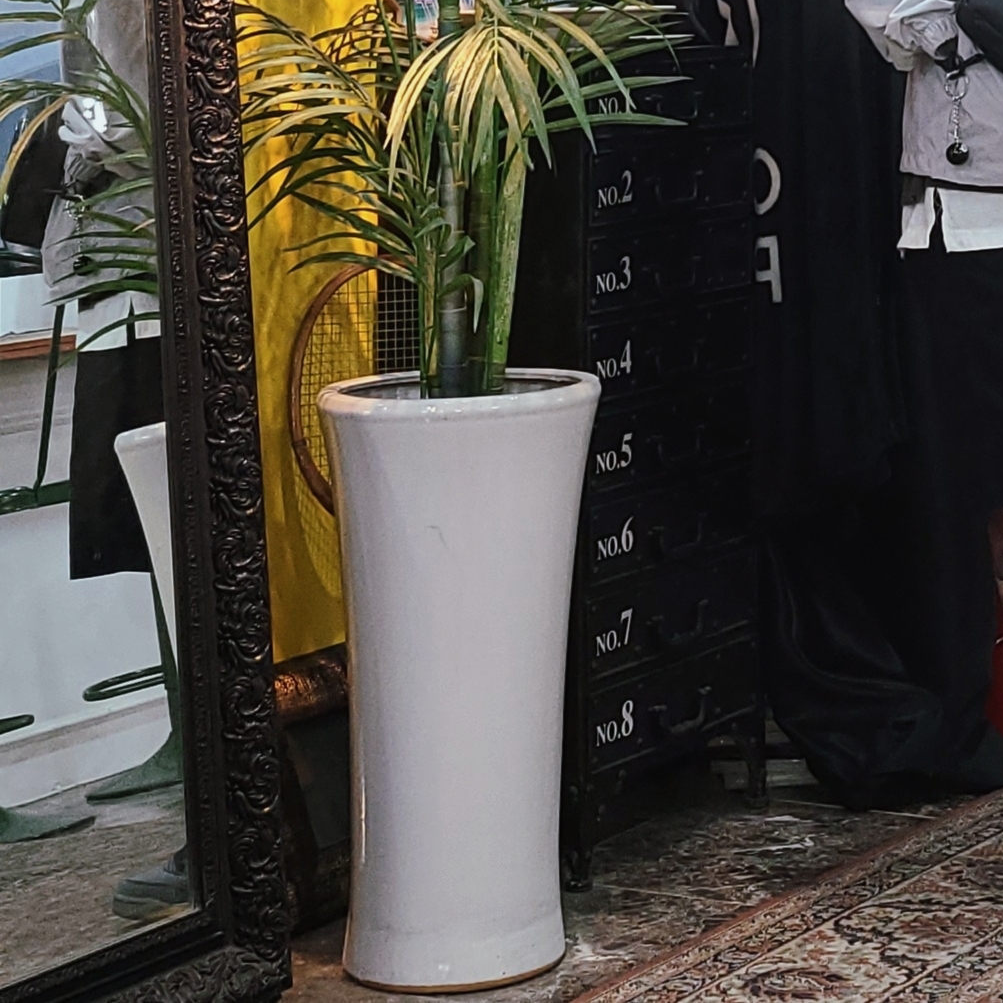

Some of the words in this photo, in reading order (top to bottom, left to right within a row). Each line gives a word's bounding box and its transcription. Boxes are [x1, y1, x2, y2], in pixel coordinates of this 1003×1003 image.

[597, 170, 633, 208] NO.2
[596, 256, 631, 294] NO.3
[597, 340, 632, 379] NO.4
[596, 433, 633, 474] NO.5
[597, 516, 634, 558] NO.6
[596, 608, 633, 657] NO.7
[596, 699, 634, 747] NO.8
